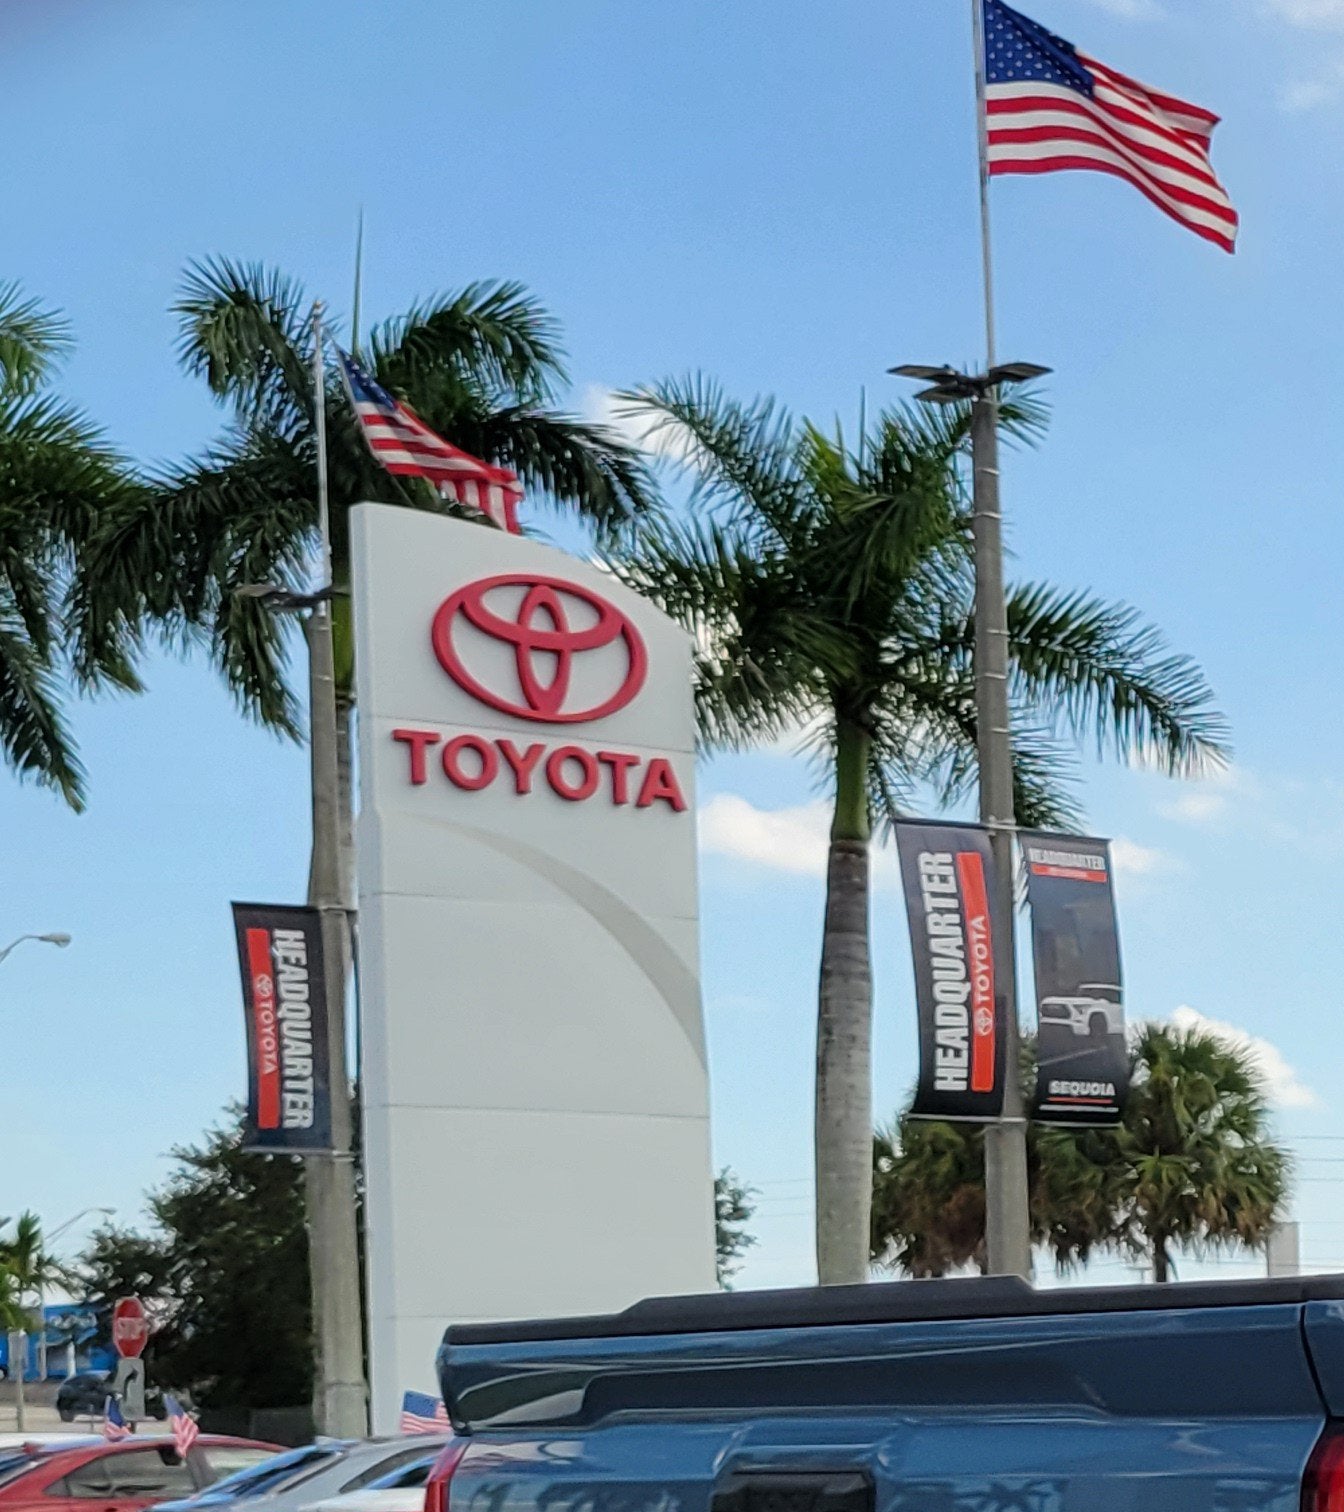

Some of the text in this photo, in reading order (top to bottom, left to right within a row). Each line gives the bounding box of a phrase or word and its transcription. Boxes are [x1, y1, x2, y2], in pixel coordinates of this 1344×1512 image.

[392, 728, 688, 813] TOYOTA
[918, 850, 971, 1092] HEADQUARTER
[970, 915, 990, 1002] TOYOTA
[259, 1001, 279, 1076] TOYOTA
[273, 928, 314, 1129] HEADQUARTER
